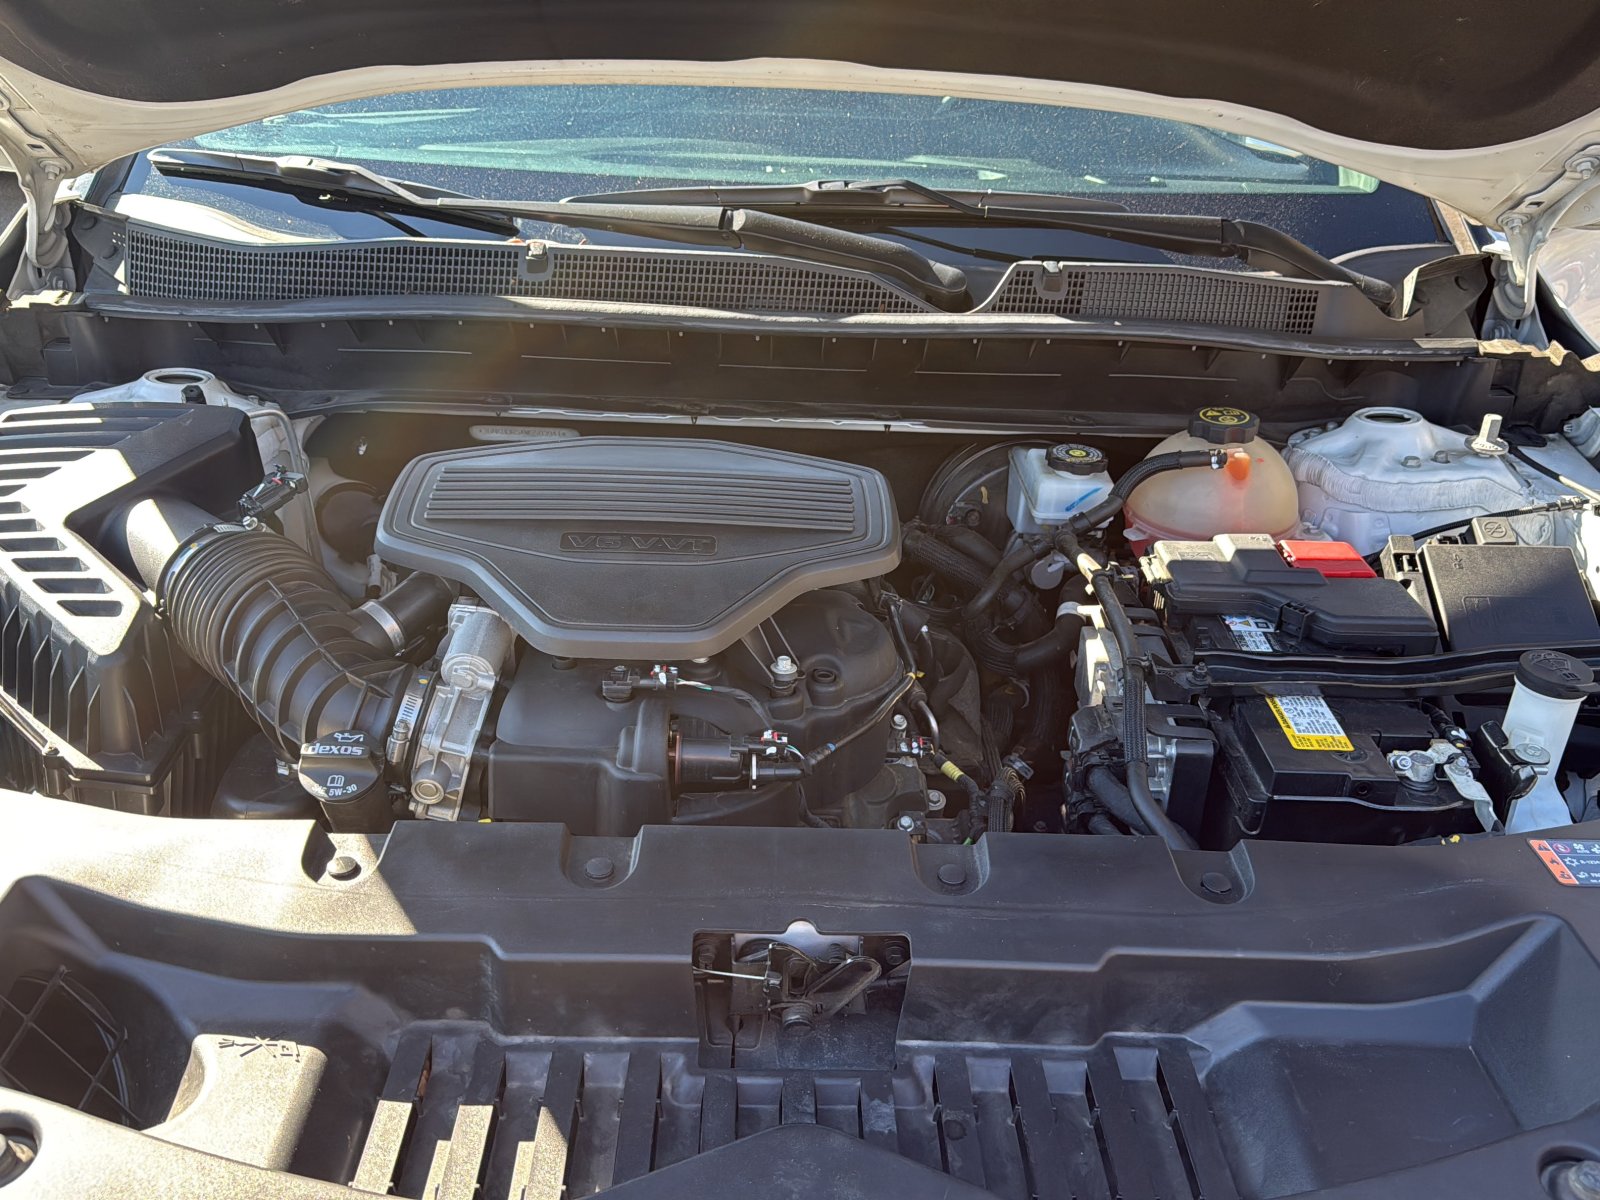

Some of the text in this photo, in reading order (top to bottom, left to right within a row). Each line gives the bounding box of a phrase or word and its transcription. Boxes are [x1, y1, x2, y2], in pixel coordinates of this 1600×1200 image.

[567, 534, 623, 549] V6
[309, 743, 365, 756] dexos
[311, 783, 358, 797] SAE 5W-30
